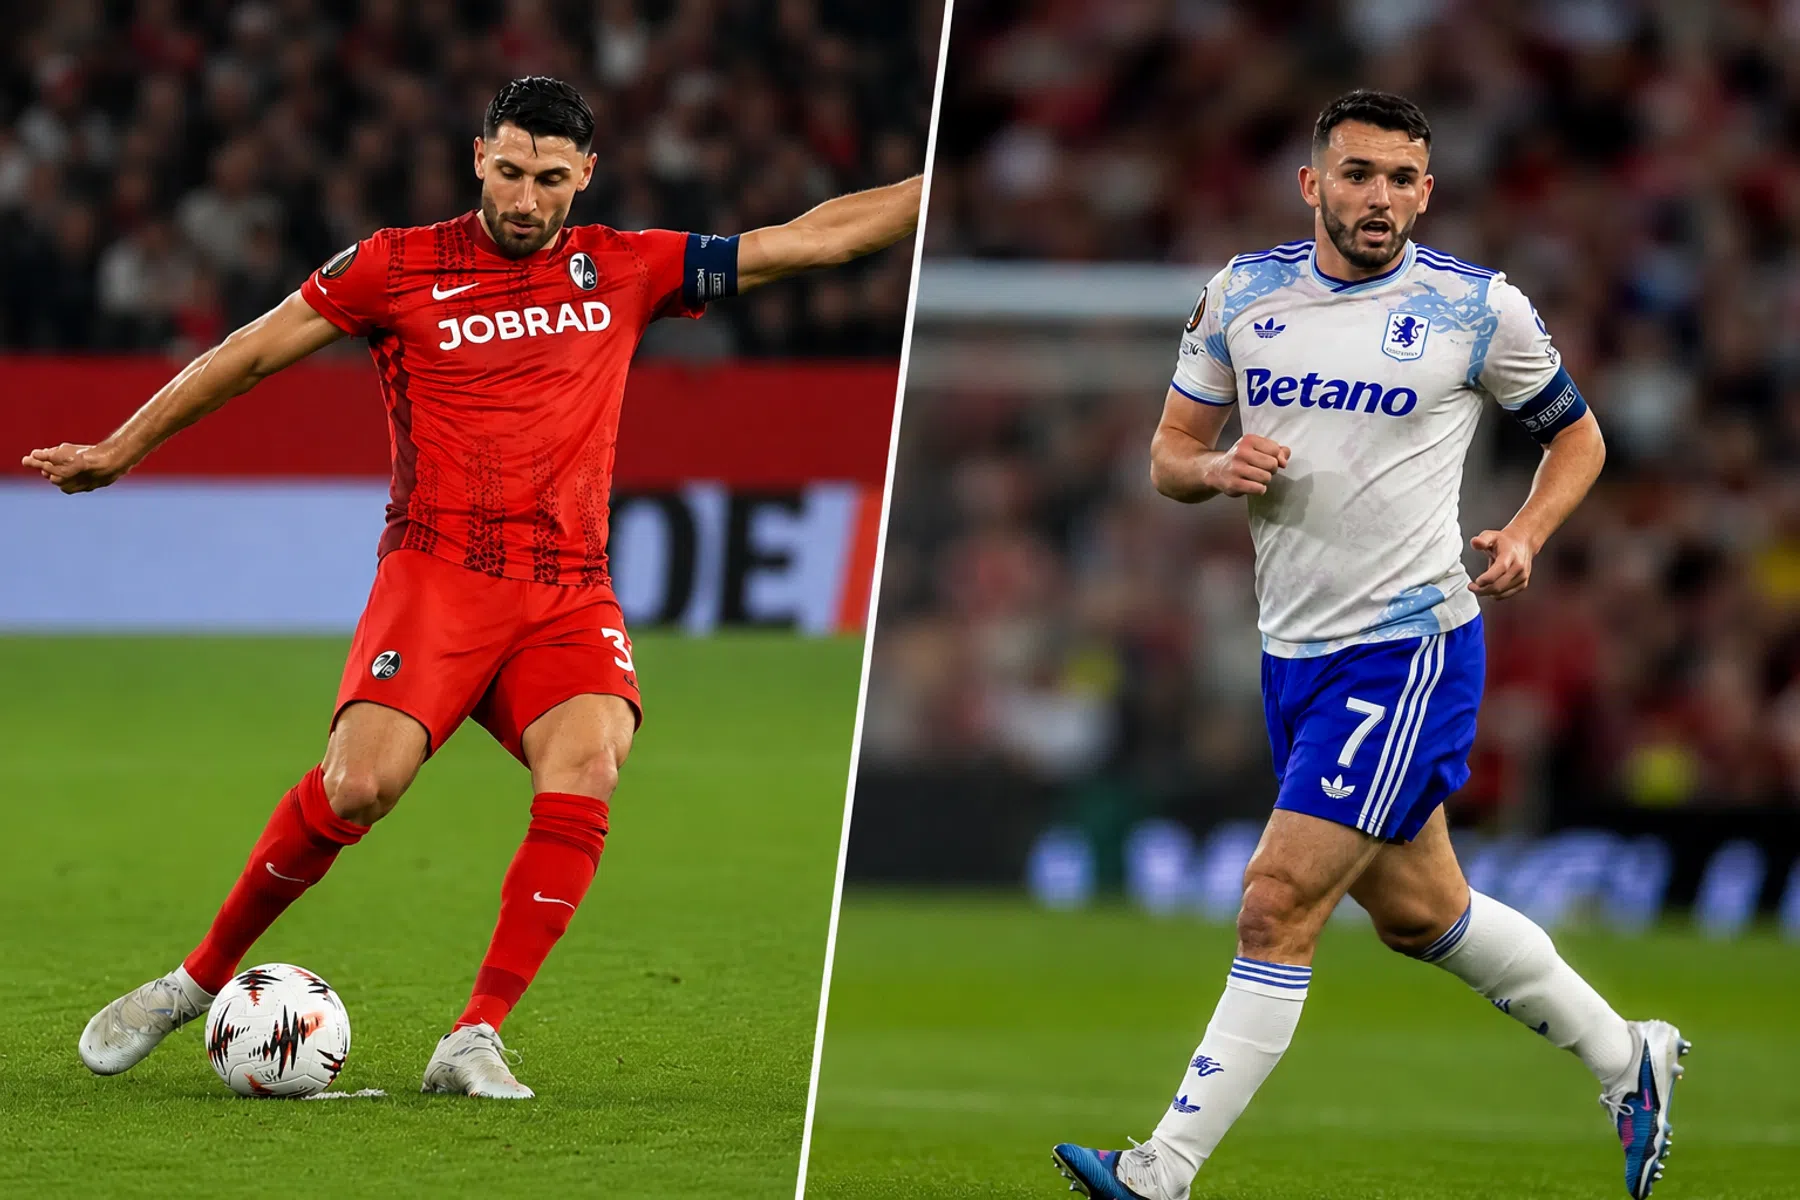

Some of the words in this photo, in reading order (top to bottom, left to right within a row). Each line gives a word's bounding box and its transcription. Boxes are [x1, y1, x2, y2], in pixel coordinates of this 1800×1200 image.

[438, 301, 611, 351] JOBRAD
[1244, 367, 1418, 417] Betano
[1337, 696, 1386, 768] 7
